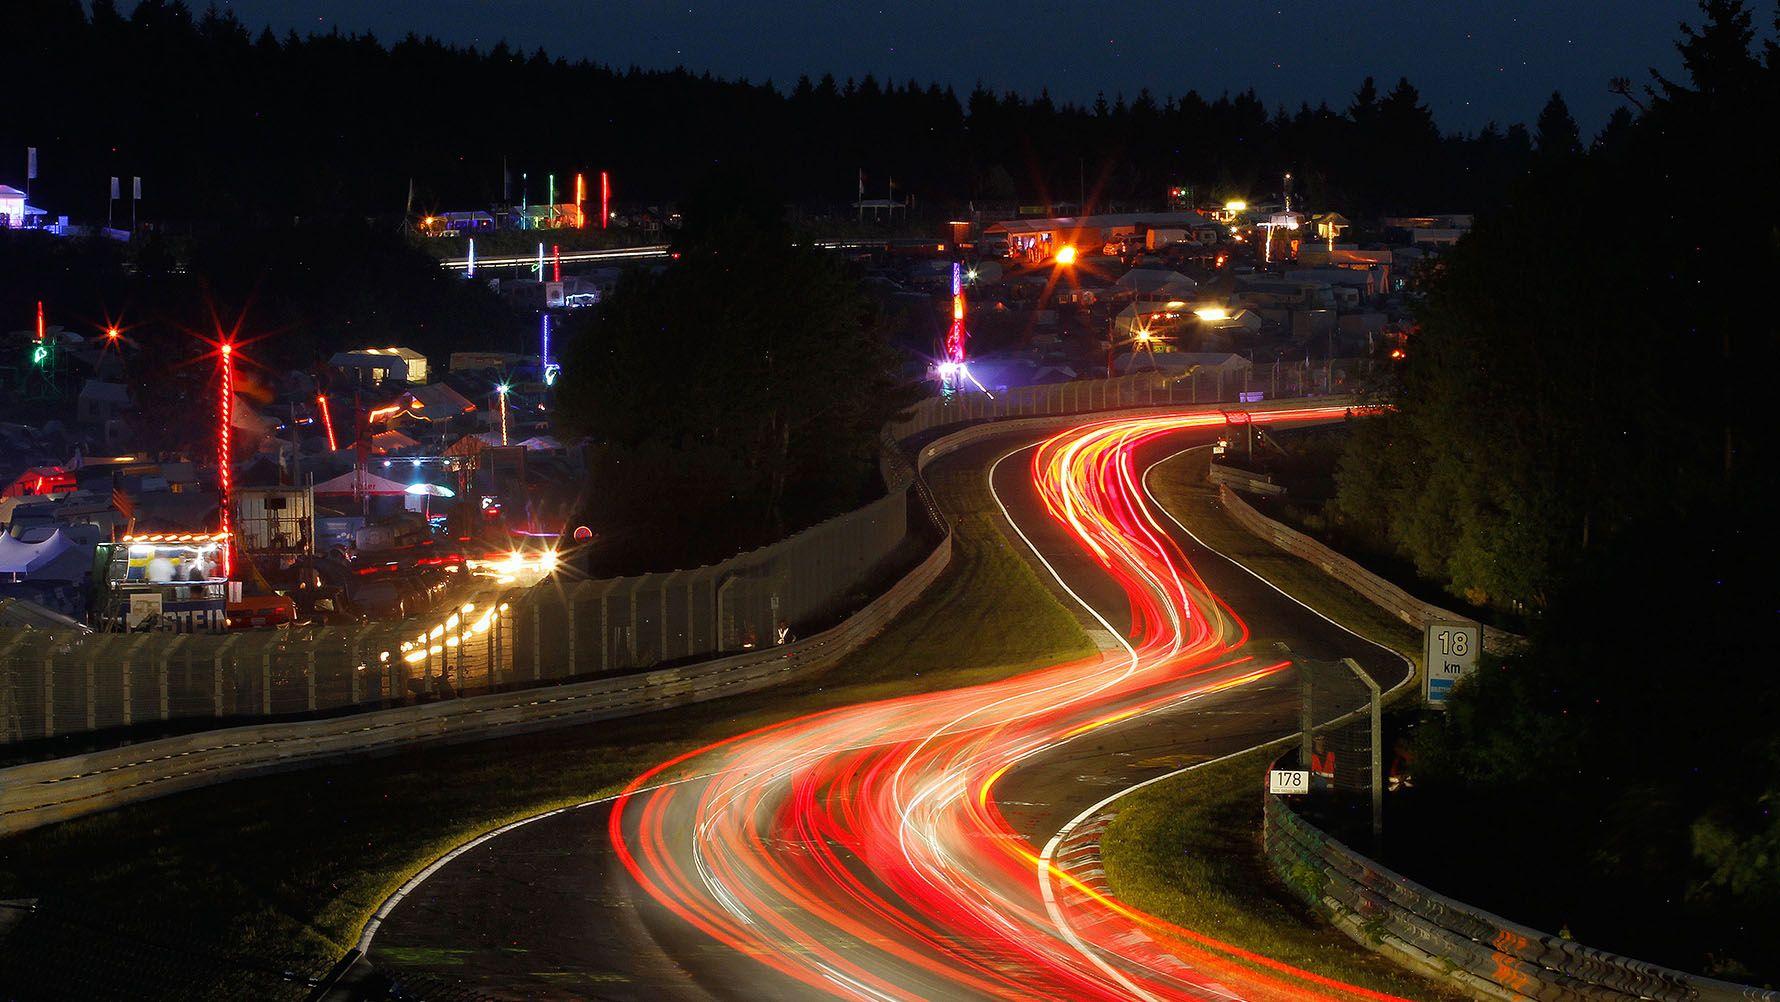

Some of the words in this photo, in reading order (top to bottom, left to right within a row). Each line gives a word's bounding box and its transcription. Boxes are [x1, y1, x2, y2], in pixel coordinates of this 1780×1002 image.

[1439, 631, 1468, 656] 18
[1444, 661, 1460, 674] km
[1278, 772, 1301, 786] 178
